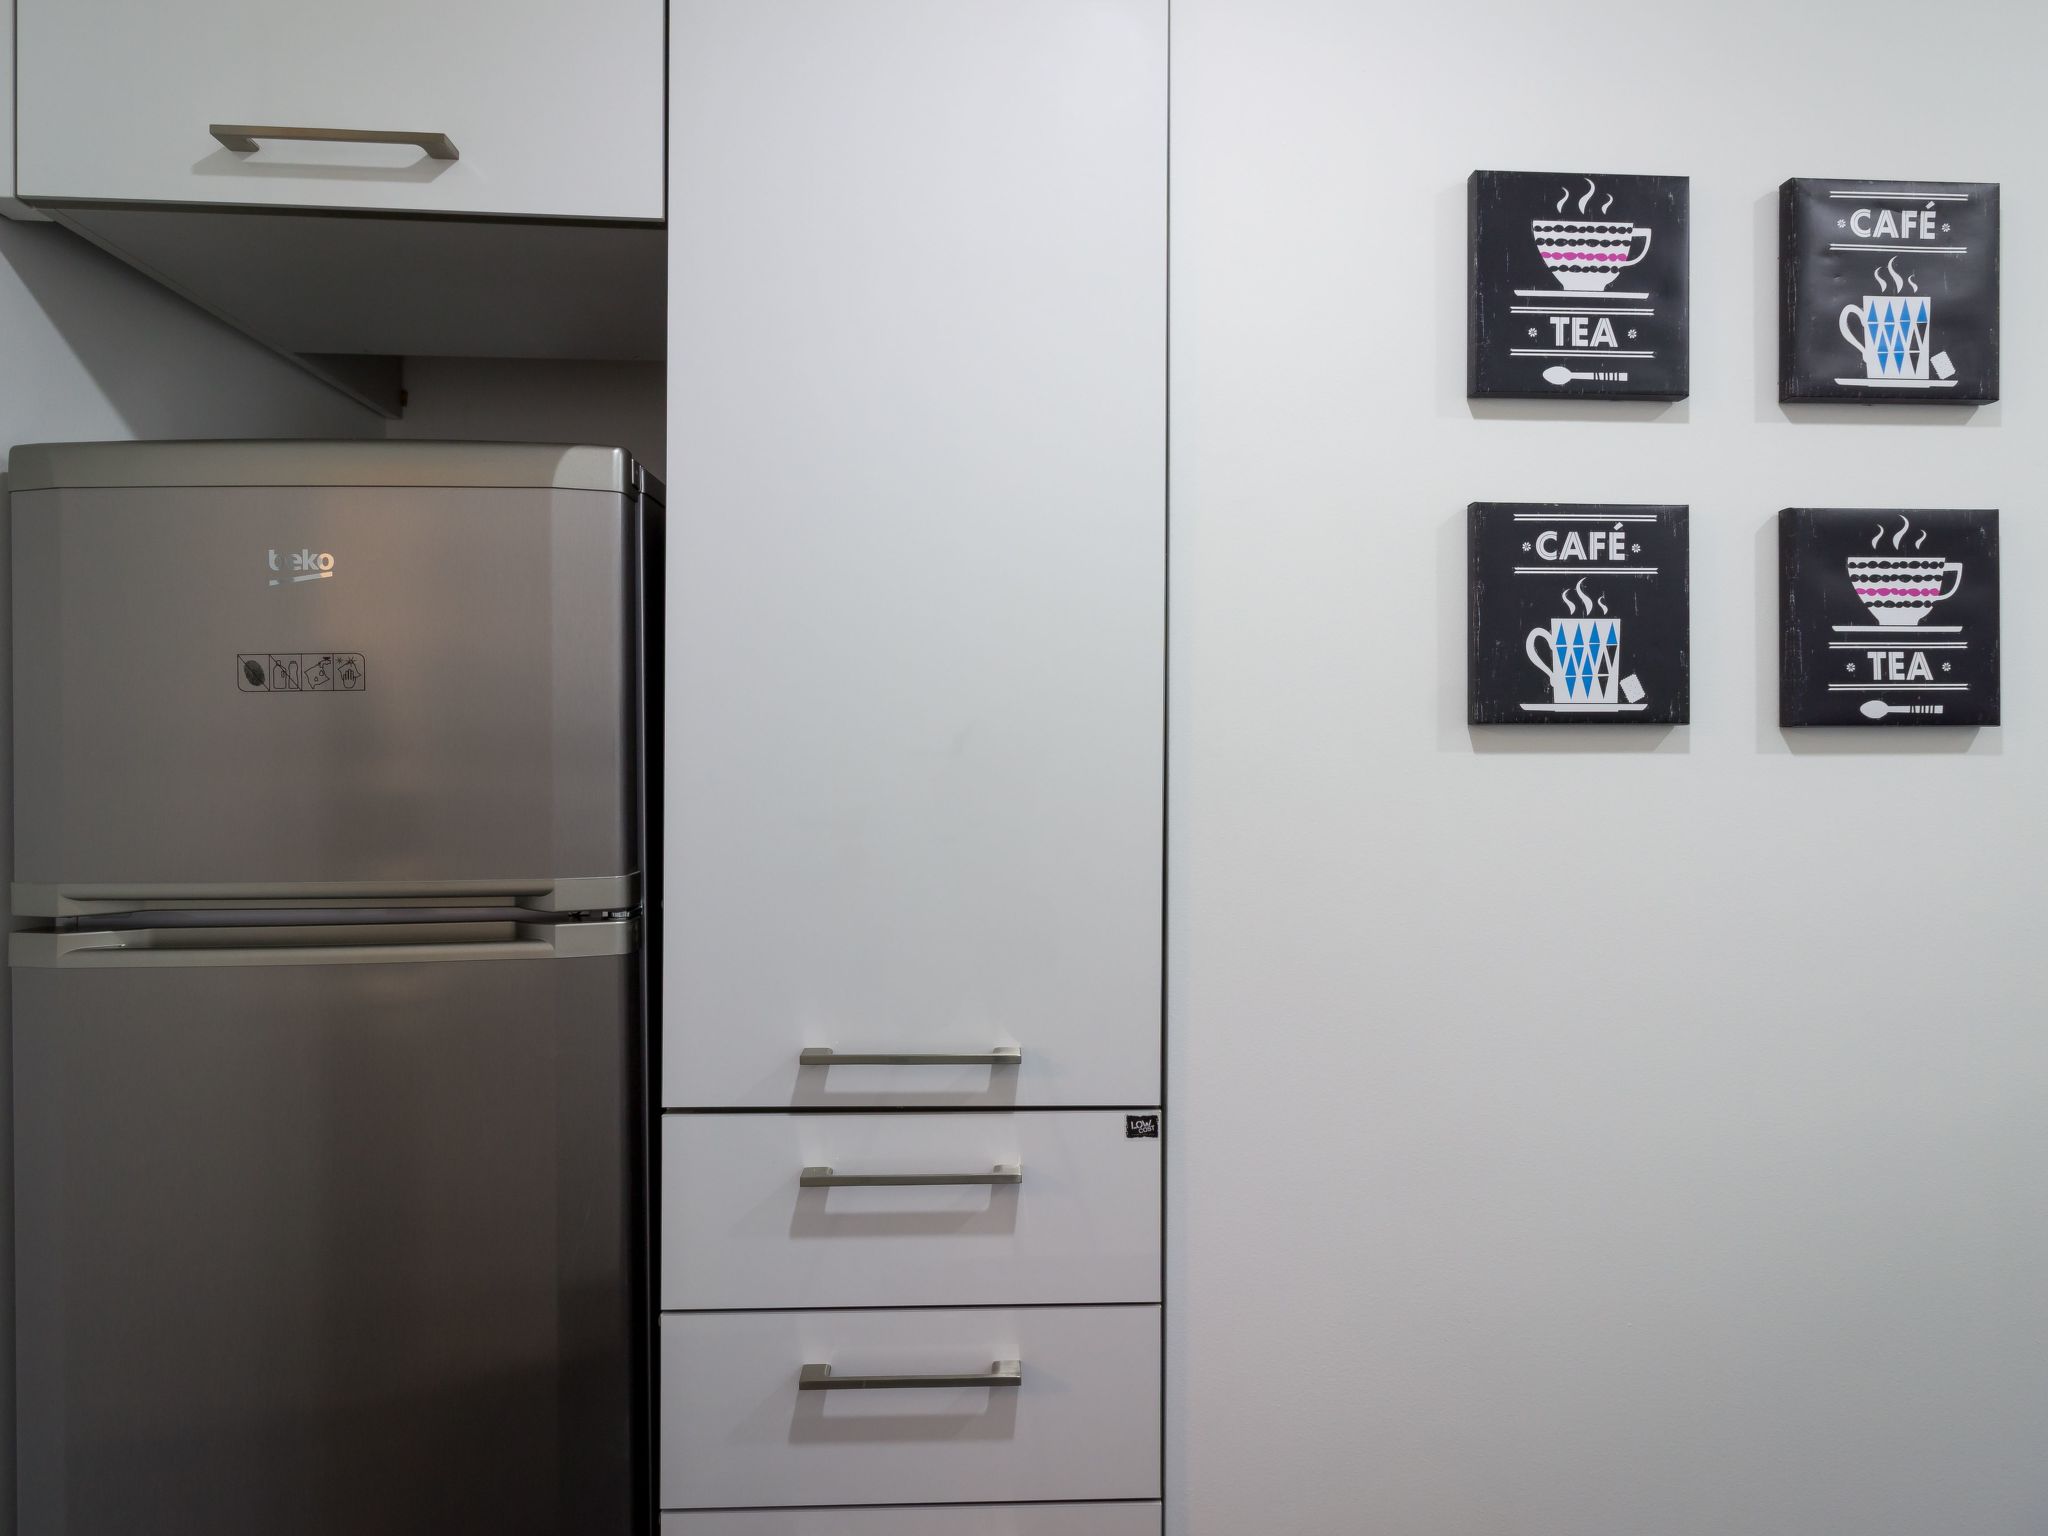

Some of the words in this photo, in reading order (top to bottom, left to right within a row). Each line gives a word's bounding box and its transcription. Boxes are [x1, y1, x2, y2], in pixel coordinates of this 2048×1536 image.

[1850, 201, 1936, 239] CAFÉ
[1550, 317, 1618, 347] TEA
[1535, 522, 1625, 560] CAFÉ
[1867, 652, 1934, 680] TEA
[1131, 1120, 1151, 1129] LOW
